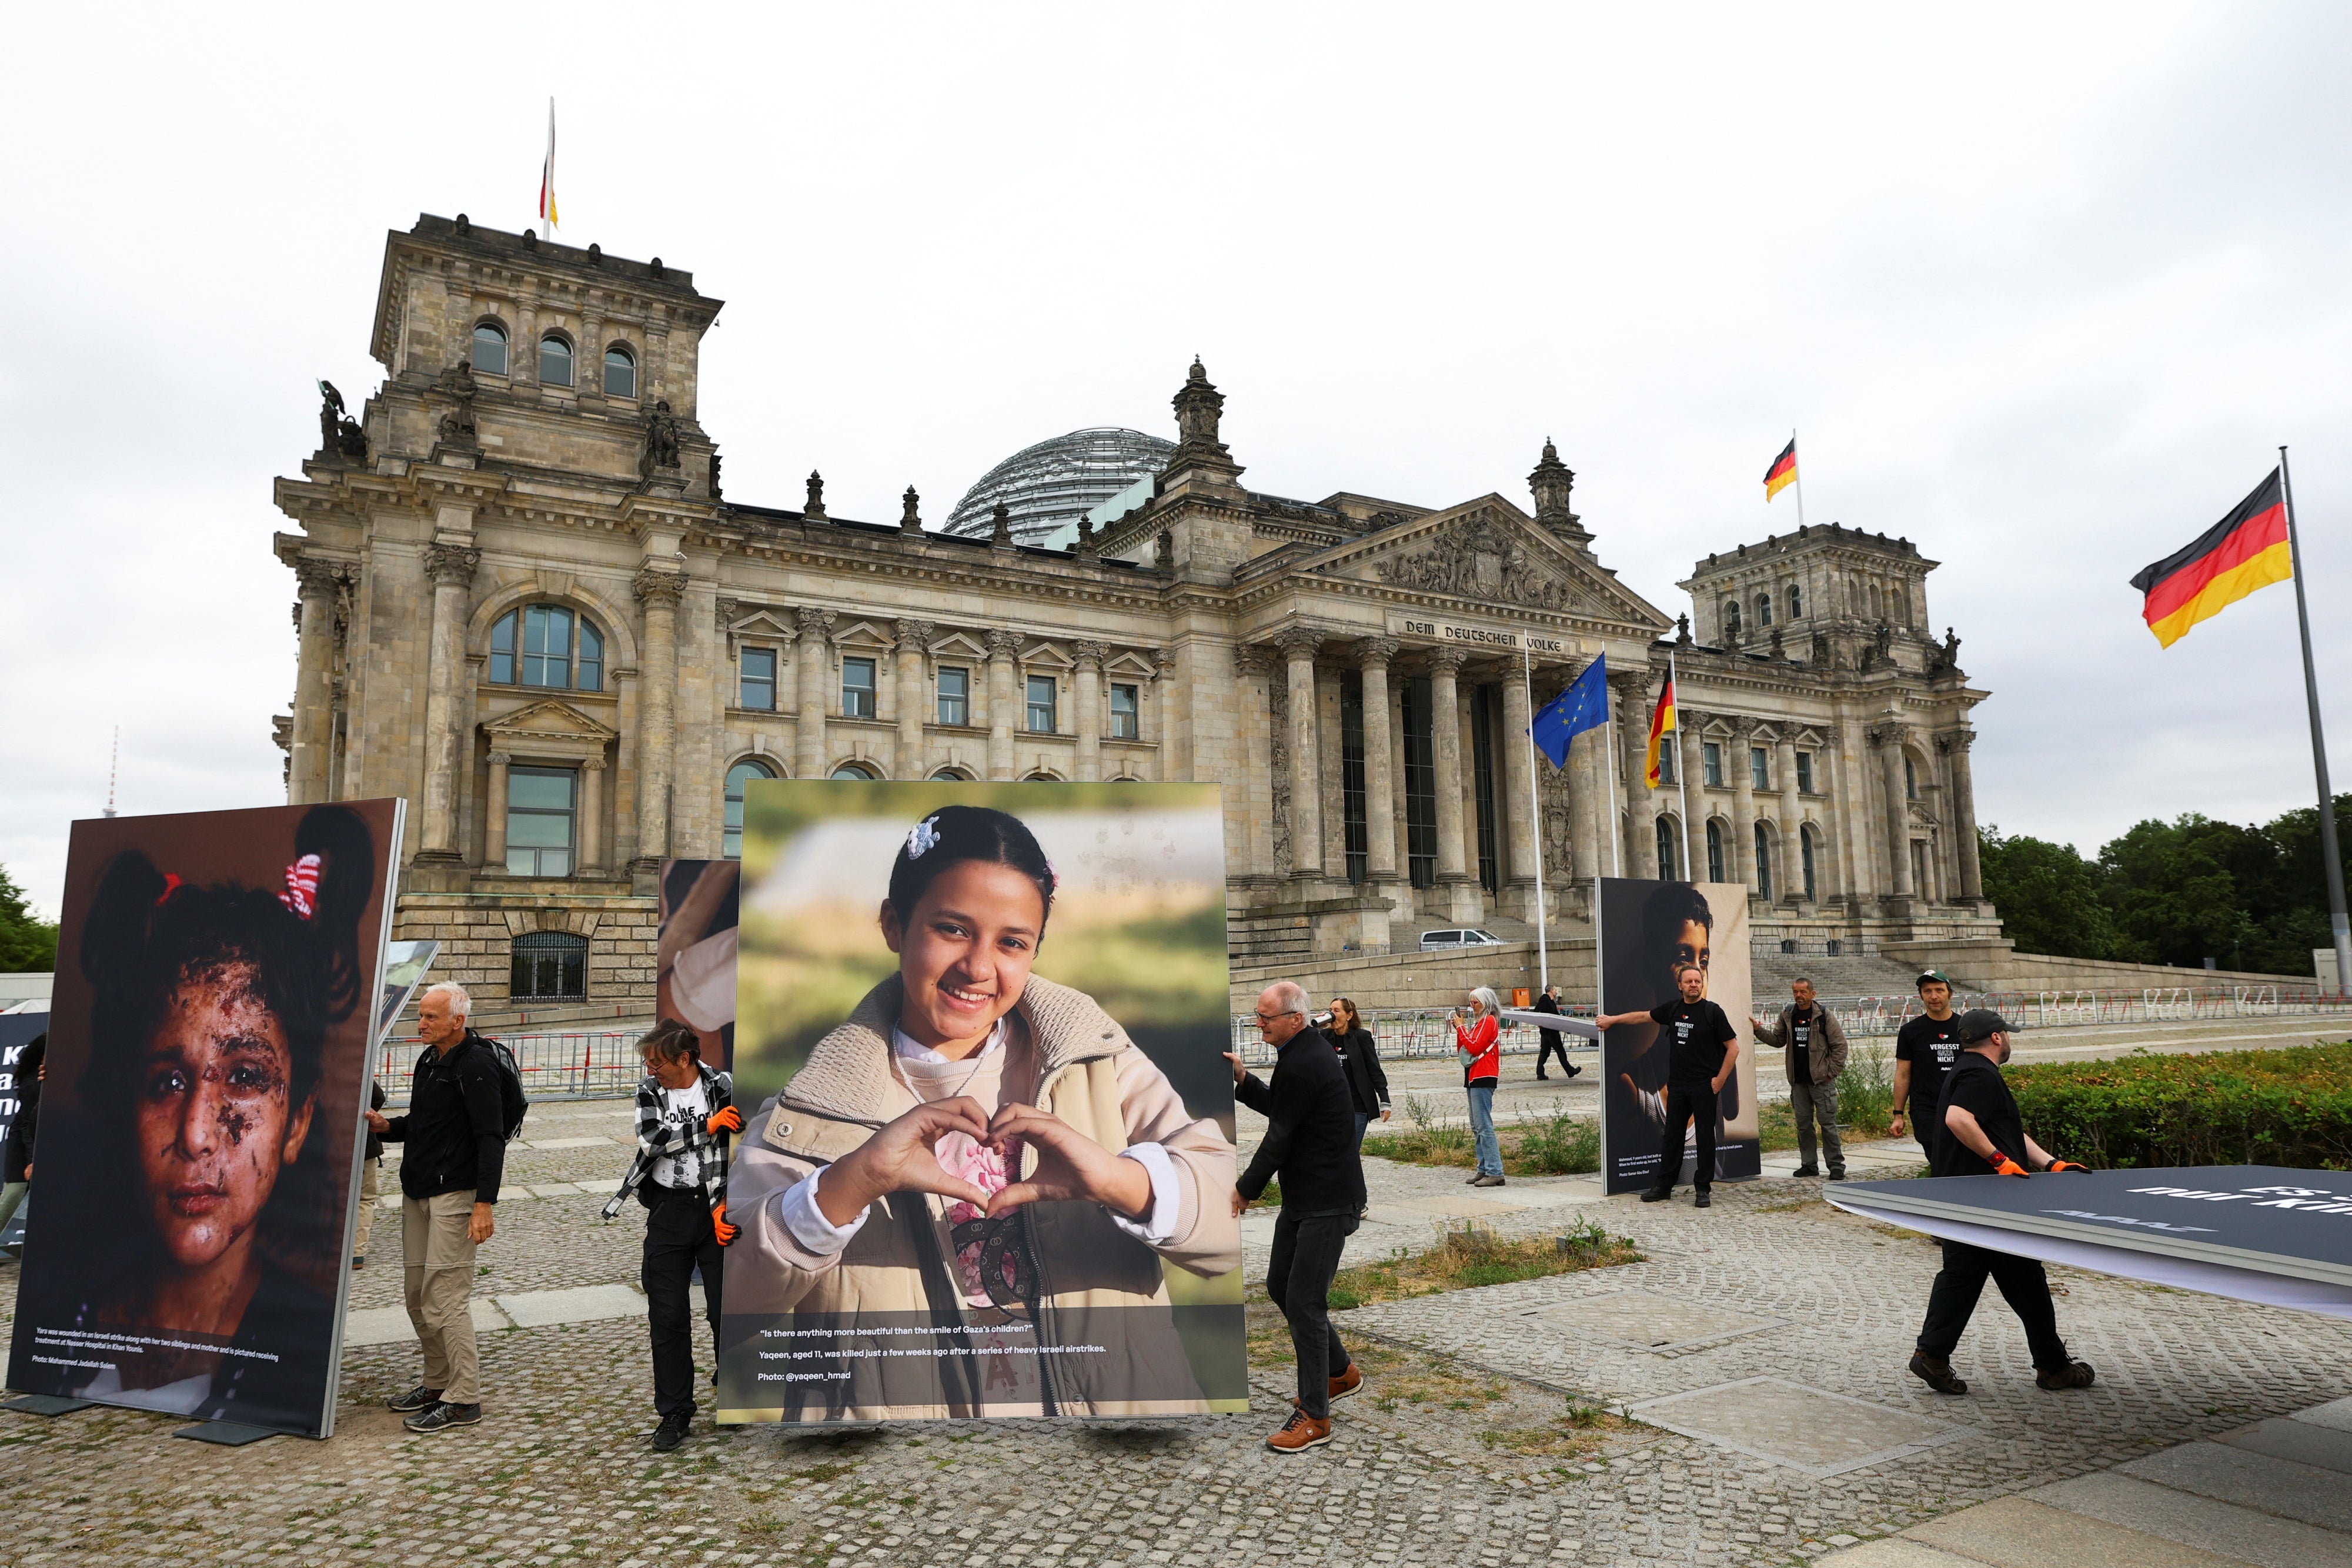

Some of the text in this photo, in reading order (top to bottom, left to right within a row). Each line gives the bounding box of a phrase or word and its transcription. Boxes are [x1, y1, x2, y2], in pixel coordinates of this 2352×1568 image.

[1405, 621, 1561, 652] DEM DEUTSCHEN VOLKE
[2038, 1209, 2219, 1232] AVAAZ
[760, 1329, 772, 1338] “Is
[773, 1329, 796, 1337] there
[797, 1328, 833, 1338] anything
[857, 1327, 893, 1336] beautiful
[963, 1325, 990, 1333] Gaza’s
[991, 1324, 1034, 1333] children?”
[35, 1337, 60, 1346] treatment
[66, 1339, 85, 1348] Nasser
[85, 1340, 106, 1350] Hospital
[58, 1329, 81, 1338] wounded
[94, 1332, 109, 1340] Israeli
[125, 1335, 140, 1345] along
[171, 1340, 191, 1350] siblings
[201, 1344, 219, 1352] mother
[234, 1348, 256, 1358] pictured
[256, 1353, 279, 1363] receiving
[32, 1355, 48, 1363] Photo:
[759, 1352, 791, 1360] Yaqeen,
[793, 1351, 813, 1360] aged
[865, 1349, 881, 1359] just
[906, 1348, 931, 1356] weeks
[933, 1349, 948, 1358] ago
[1014, 1346, 1038, 1355] heavy
[1040, 1345, 1064, 1353] Israeli
[1065, 1344, 1107, 1353] airstrikes.
[757, 1371, 851, 1383] Photo: @yaqeen_hmad
